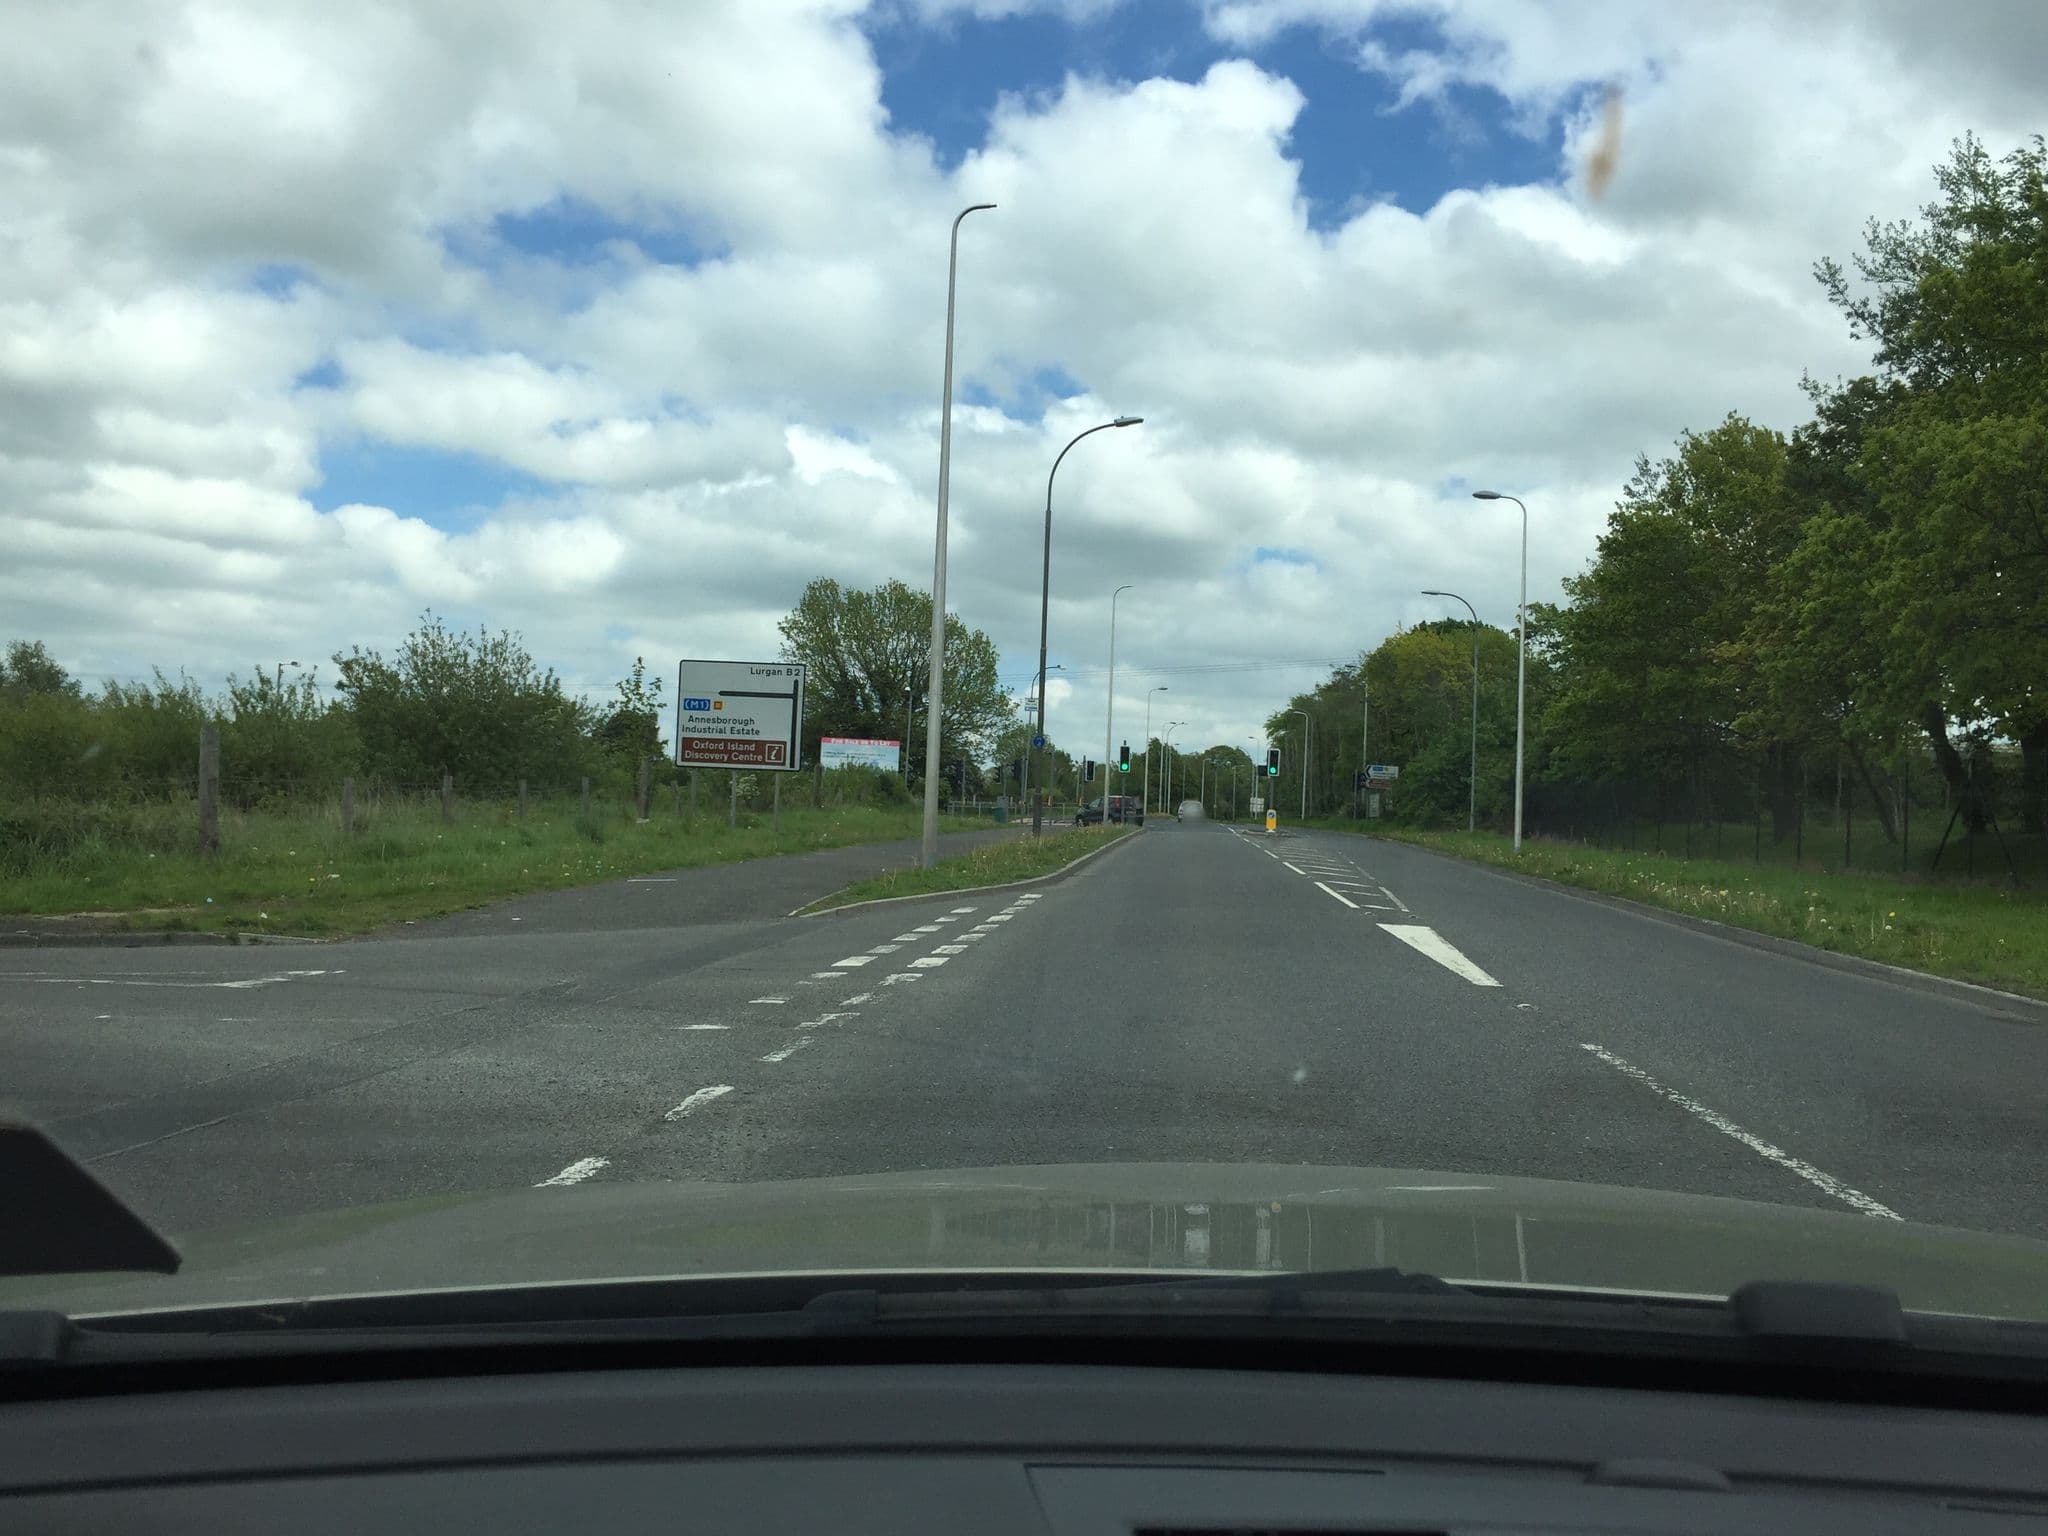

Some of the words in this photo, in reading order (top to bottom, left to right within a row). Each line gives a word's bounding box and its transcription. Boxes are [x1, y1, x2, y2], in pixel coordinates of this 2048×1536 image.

[750, 667, 783, 677] Lurgan
[786, 668, 801, 677] B2
[684, 699, 710, 711] (M1)
[688, 715, 755, 726] Annesborough
[682, 725, 727, 735] Industrial
[730, 726, 760, 736] Estate
[692, 740, 724, 750] Oxford
[727, 742, 756, 751] Island
[685, 750, 729, 761] Discovery
[731, 752, 763, 762] Centre
